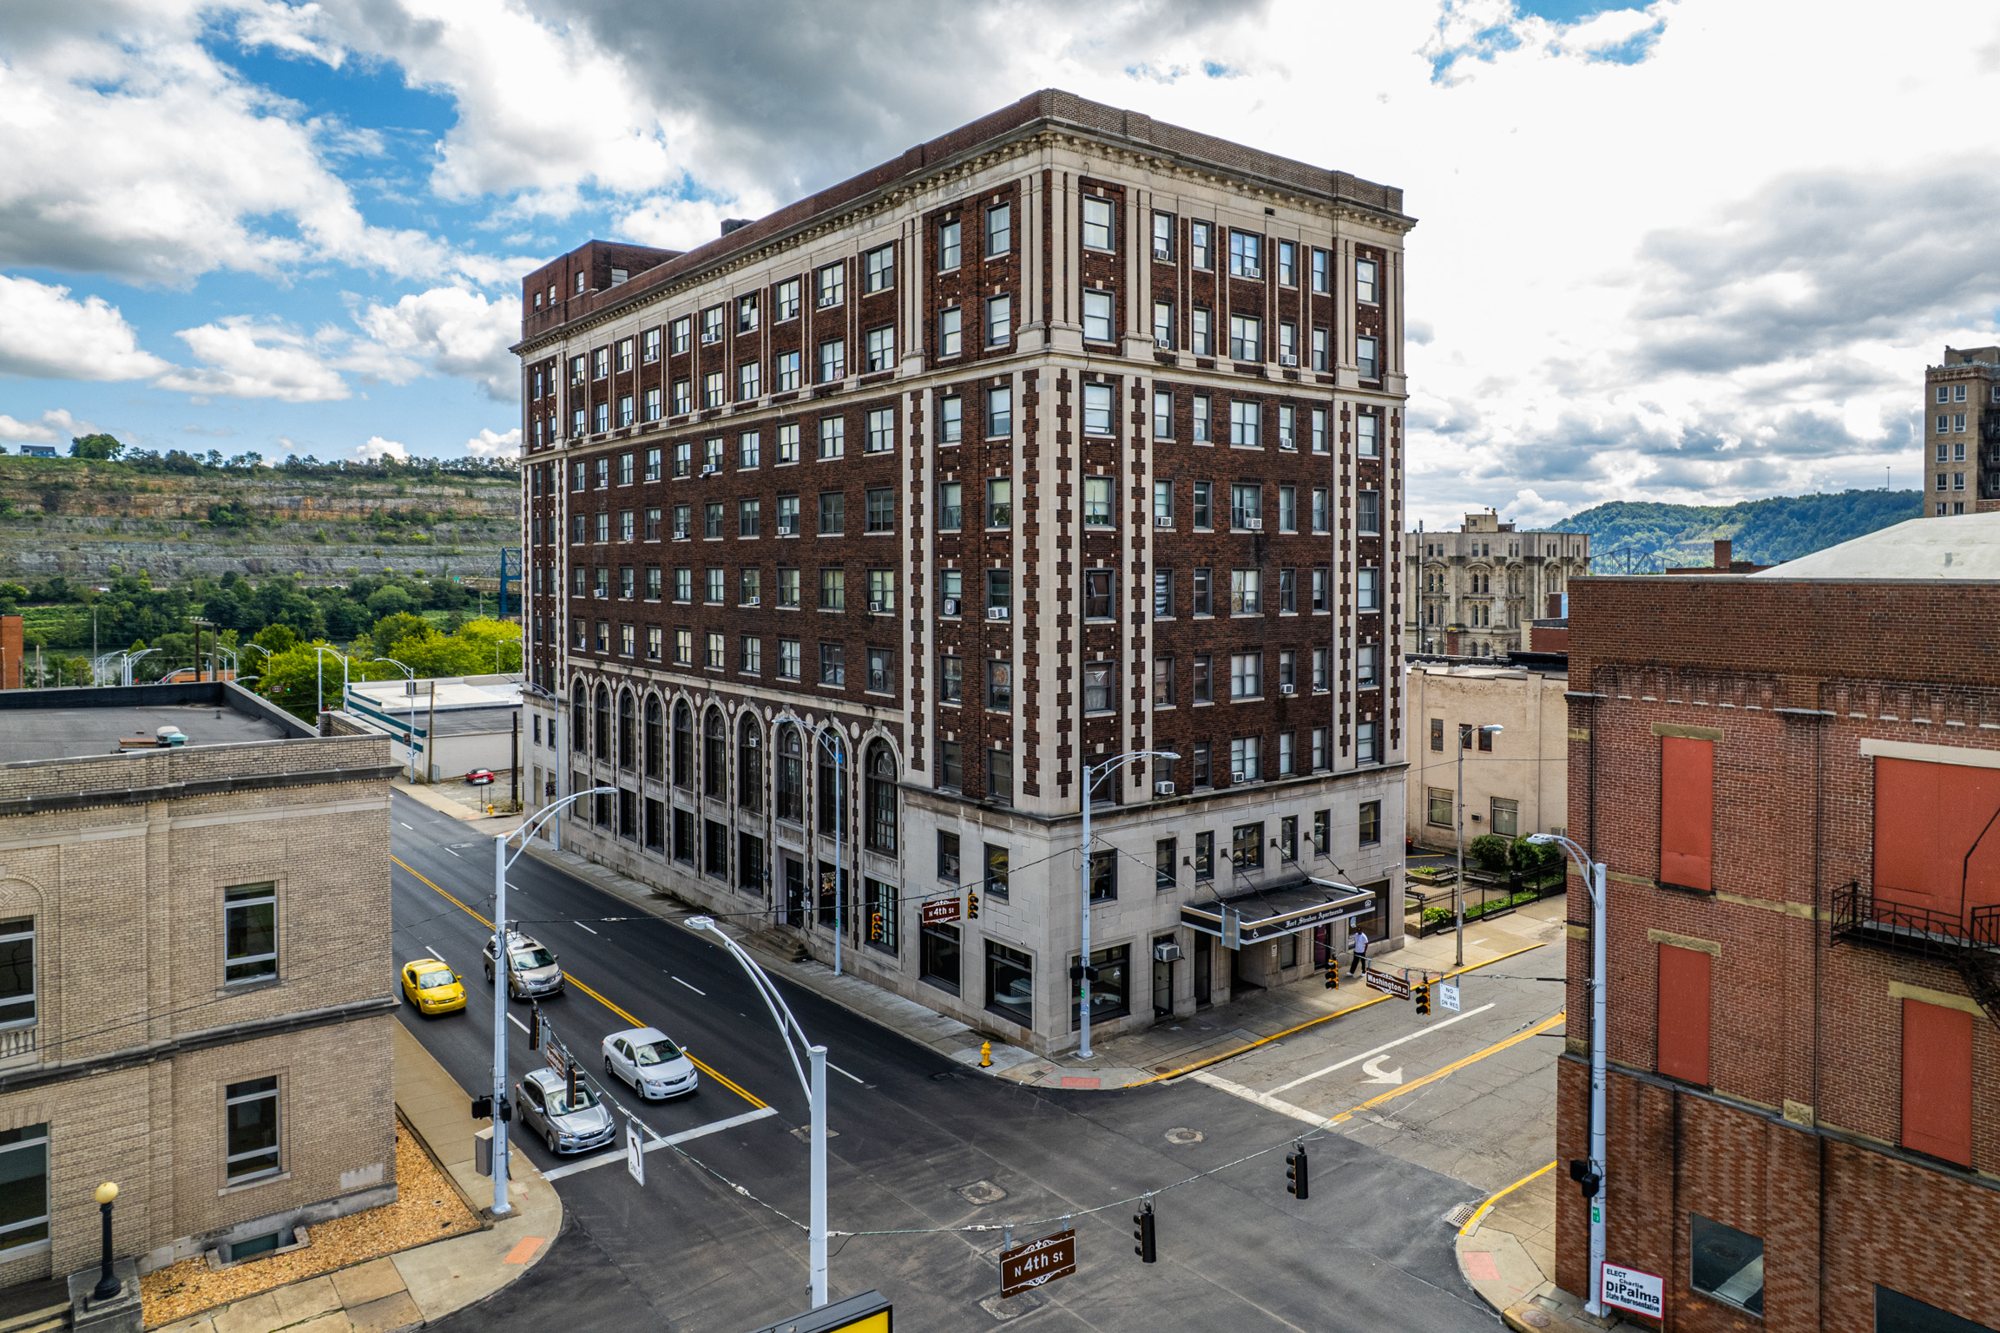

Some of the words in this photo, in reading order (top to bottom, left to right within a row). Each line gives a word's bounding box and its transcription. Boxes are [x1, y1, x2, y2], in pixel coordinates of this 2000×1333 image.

[933, 907, 947, 916] 4th
[1367, 974, 1402, 992] Washington
[1444, 993, 1457, 1001] TURN
[1014, 1265, 1022, 1278] N
[1023, 1253, 1049, 1272] 4th
[1052, 1251, 1064, 1263] St
[1606, 1268, 1627, 1278] ELECT
[1619, 1278, 1644, 1289] Charlie
[1606, 1281, 1660, 1304] DiPalma
[1605, 1291, 1620, 1301] State
[1620, 1295, 1660, 1313] Representative
